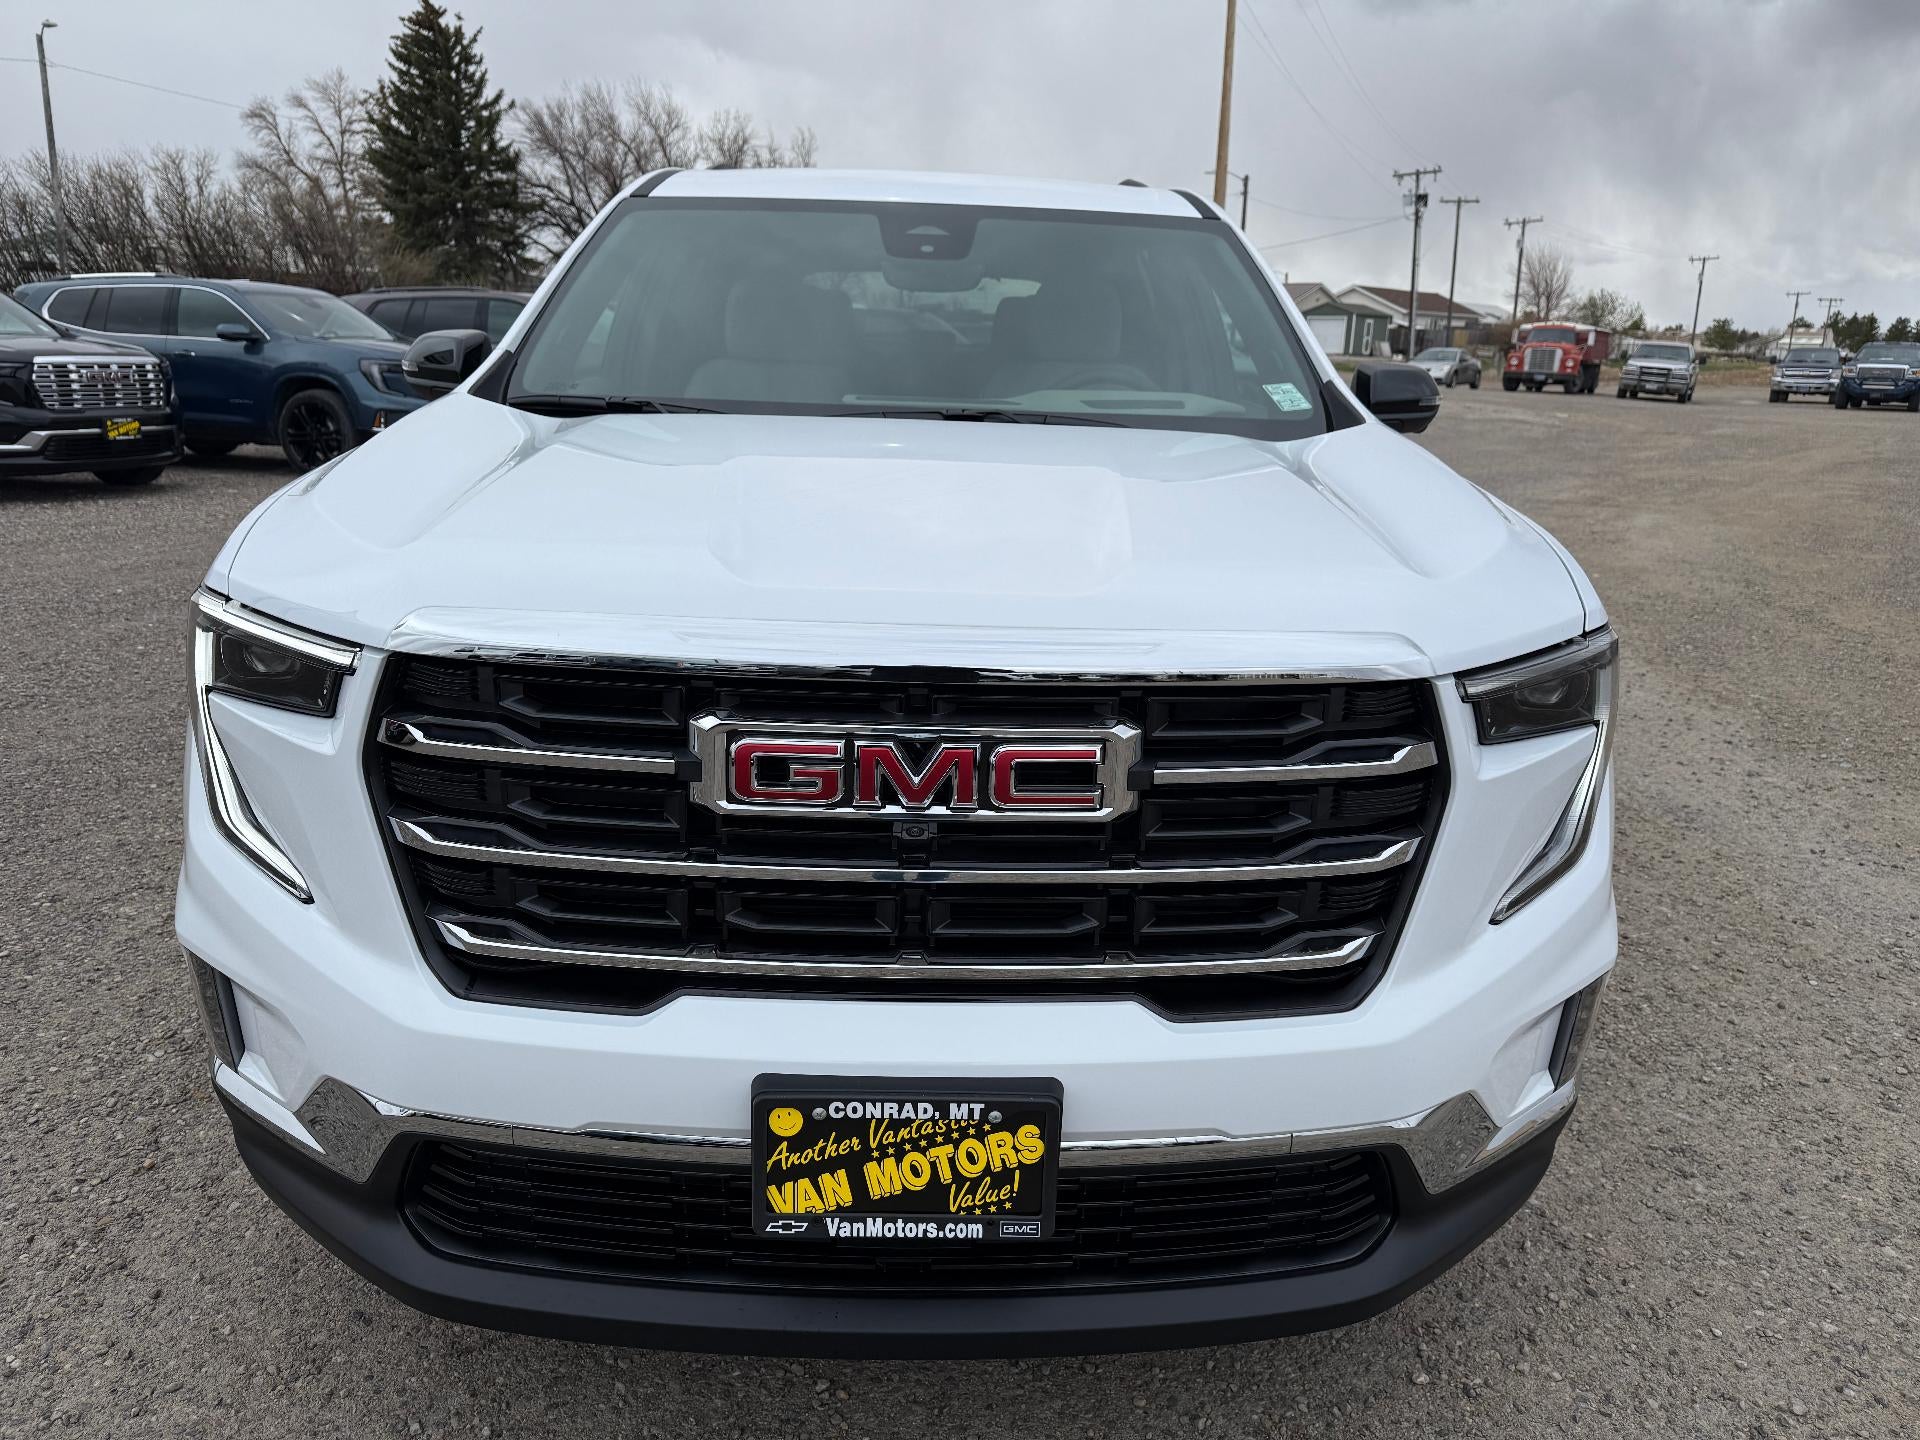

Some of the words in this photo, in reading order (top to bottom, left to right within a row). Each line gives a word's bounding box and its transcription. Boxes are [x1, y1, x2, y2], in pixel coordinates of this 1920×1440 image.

[729, 738, 1105, 809] GMC
[828, 1101, 940, 1119] CONRAD,
[950, 1103, 985, 1120] MT
[767, 1132, 861, 1172] Another
[767, 1168, 853, 1214] VAN
[863, 1124, 1045, 1200] MOTORS
[949, 1169, 1020, 1214] Value!
[825, 1217, 984, 1239] VanMotors.com
[1003, 1223, 1037, 1235] GMC
